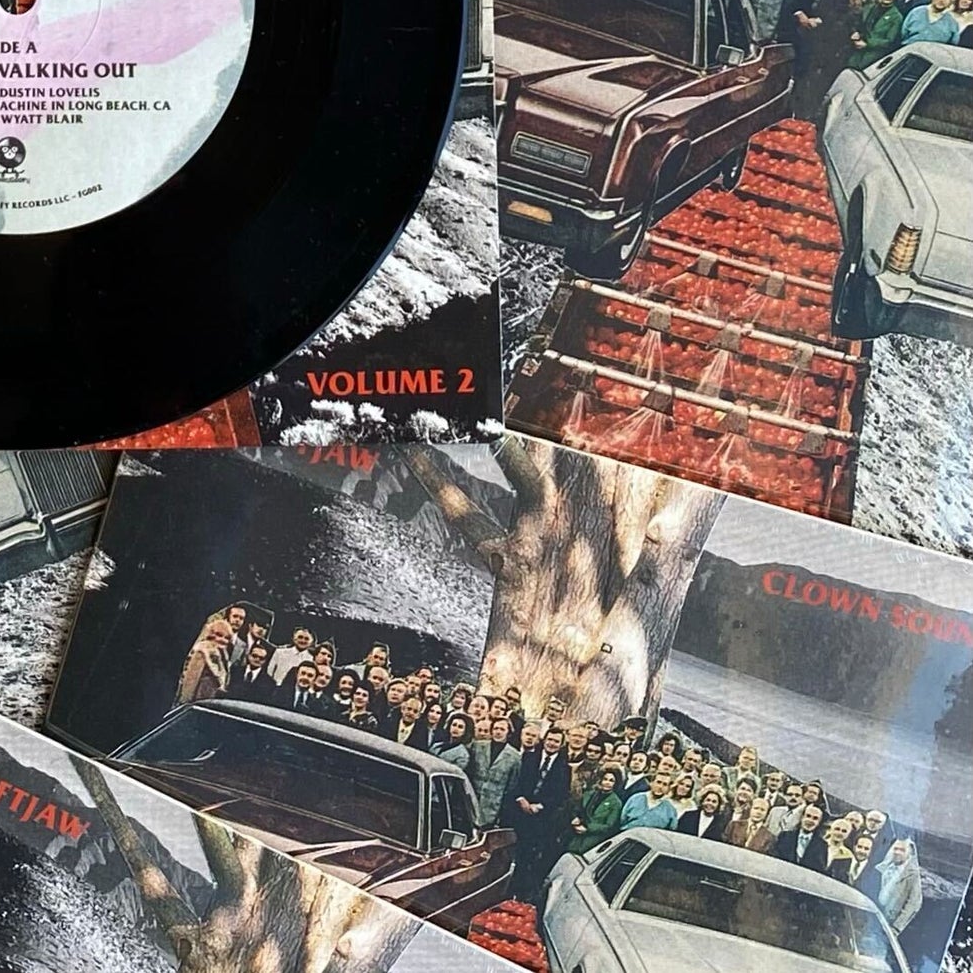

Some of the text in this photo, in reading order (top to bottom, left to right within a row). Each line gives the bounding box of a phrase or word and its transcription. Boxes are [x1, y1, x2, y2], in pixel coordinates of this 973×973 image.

[26, 40, 37, 54] A
[94, 62, 137, 78] OUT
[0, 87, 45, 98] DUSTIN
[49, 87, 100, 98] LOVELIS
[51, 101, 64, 111] IN
[68, 101, 103, 111] LONG
[153, 101, 171, 111] CA
[1, 114, 43, 124] WYATT
[46, 114, 83, 124] BLAIR
[12, 198, 53, 209] RECORDS
[54, 194, 70, 204] LLC
[307, 368, 475, 396] VOLUME 2
[762, 568, 884, 623] CLOWN
